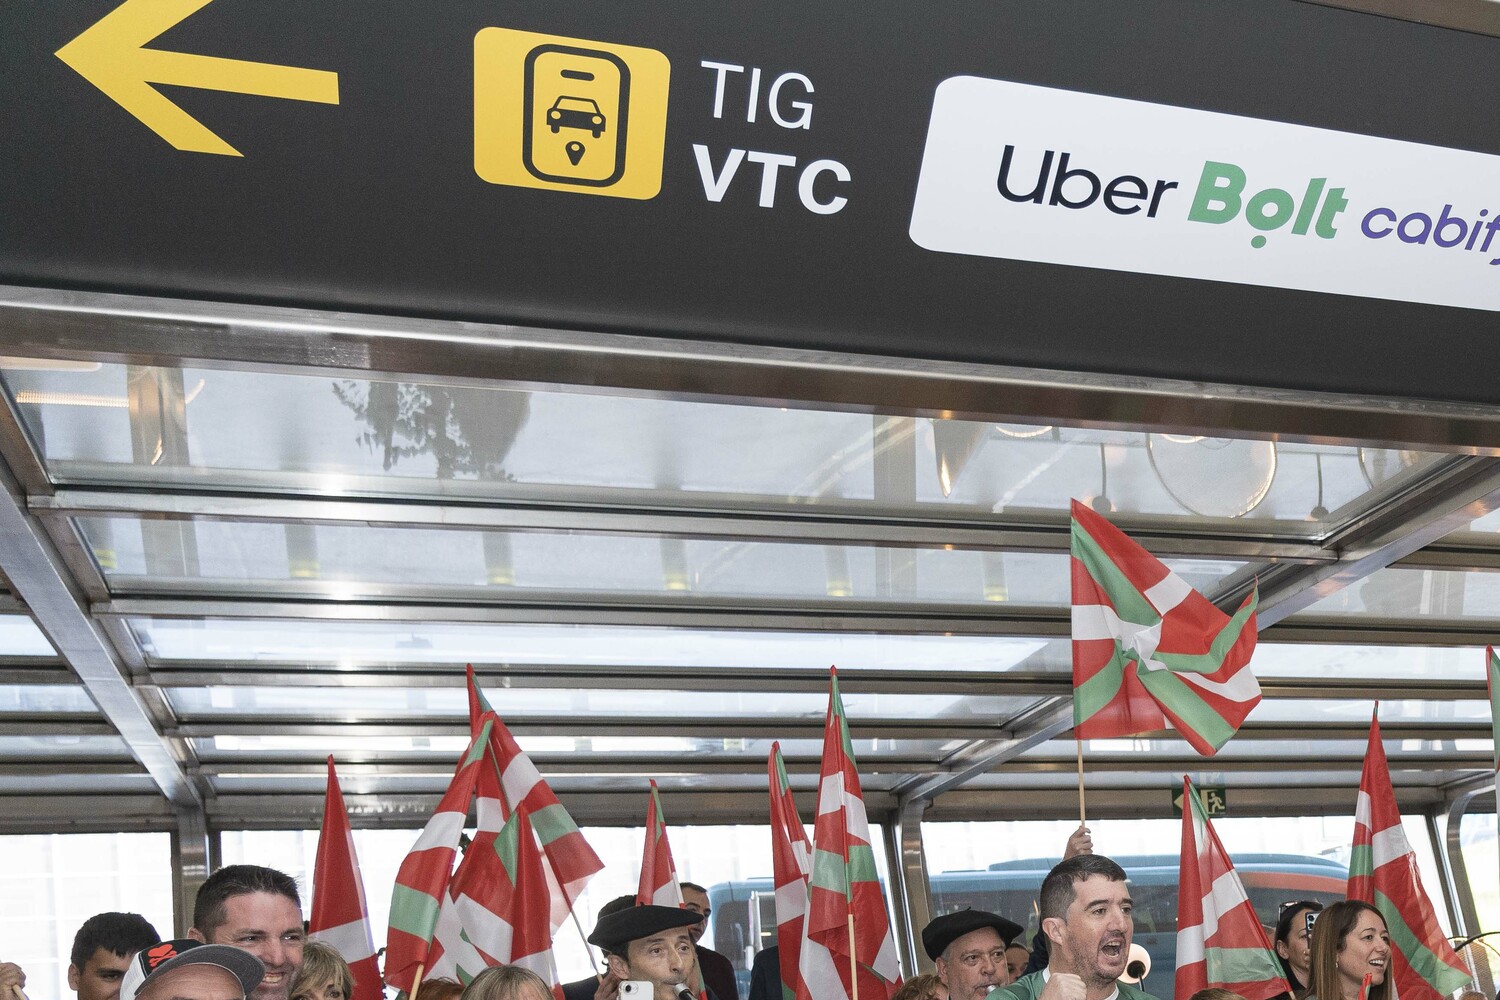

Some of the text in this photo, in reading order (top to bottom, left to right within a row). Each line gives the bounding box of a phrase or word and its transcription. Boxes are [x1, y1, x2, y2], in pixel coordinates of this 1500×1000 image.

[701, 60, 815, 130] TIG
[692, 143, 852, 215] VTC
[996, 144, 1179, 218] Uber
[1187, 160, 1349, 249] Bolt
